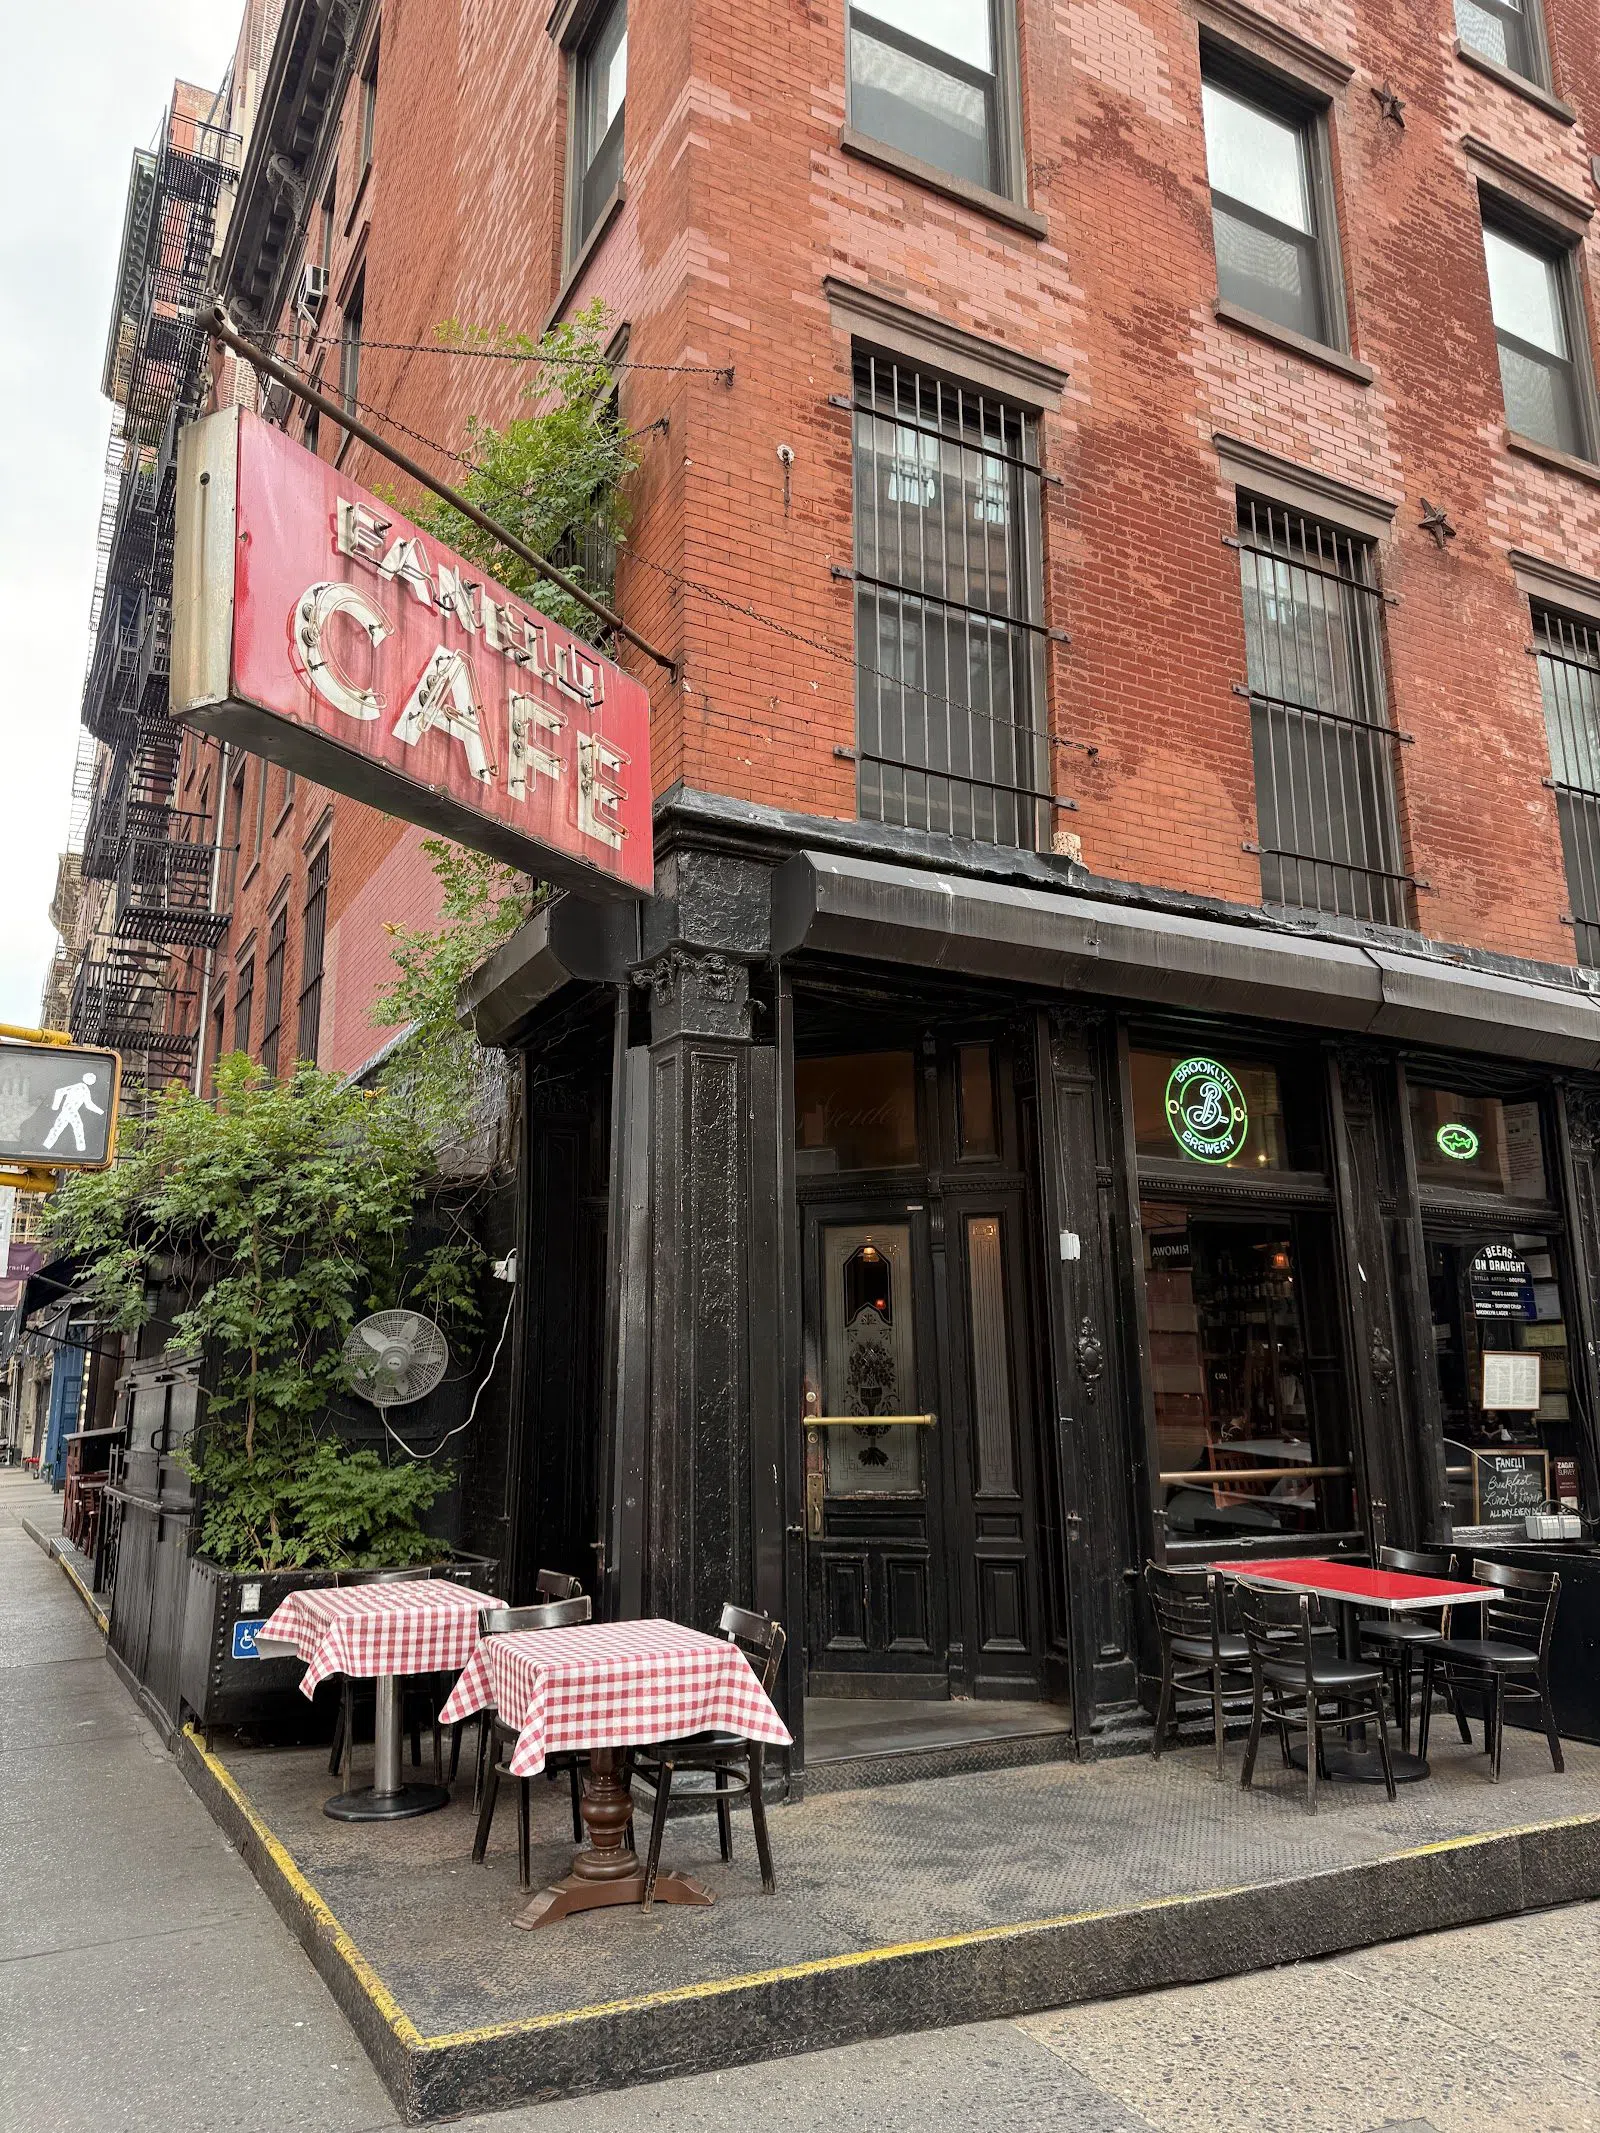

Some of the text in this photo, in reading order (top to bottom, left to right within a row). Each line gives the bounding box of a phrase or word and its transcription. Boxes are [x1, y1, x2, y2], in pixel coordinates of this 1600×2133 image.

[333, 496, 604, 711] FANELLI
[294, 582, 631, 851] CAFE
[1175, 1061, 1234, 1093] BROOKLYN
[1181, 1130, 1234, 1154] BREWERY
[1485, 1245, 1513, 1259] BEERS
[1475, 1259, 1525, 1272] ON DRAUGHT
[1495, 1457, 1525, 1471] FANELLI
[1483, 1492, 1518, 1507] Lunch
[1489, 1510, 1502, 1519] ALL
